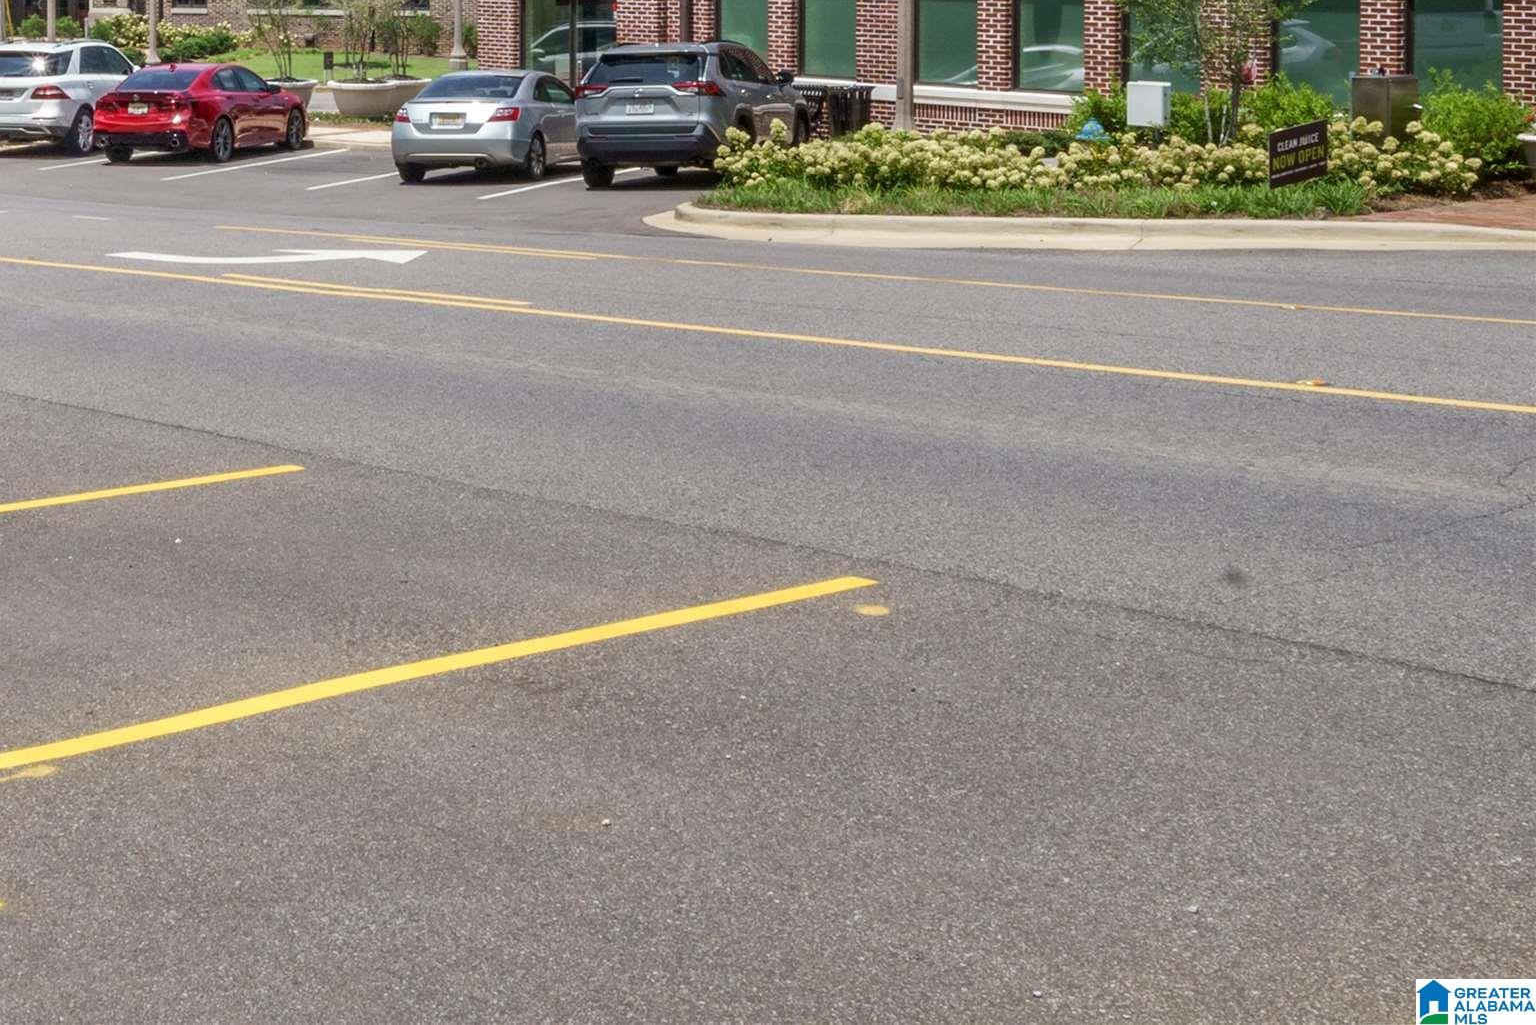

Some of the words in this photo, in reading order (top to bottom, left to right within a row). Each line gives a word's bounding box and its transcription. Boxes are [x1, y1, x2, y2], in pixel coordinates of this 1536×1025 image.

[1277, 138, 1298, 152] CLEAN
[1298, 132, 1319, 147] JUICE
[1272, 153, 1296, 171] NOW
[1298, 145, 1324, 164] OPEN
